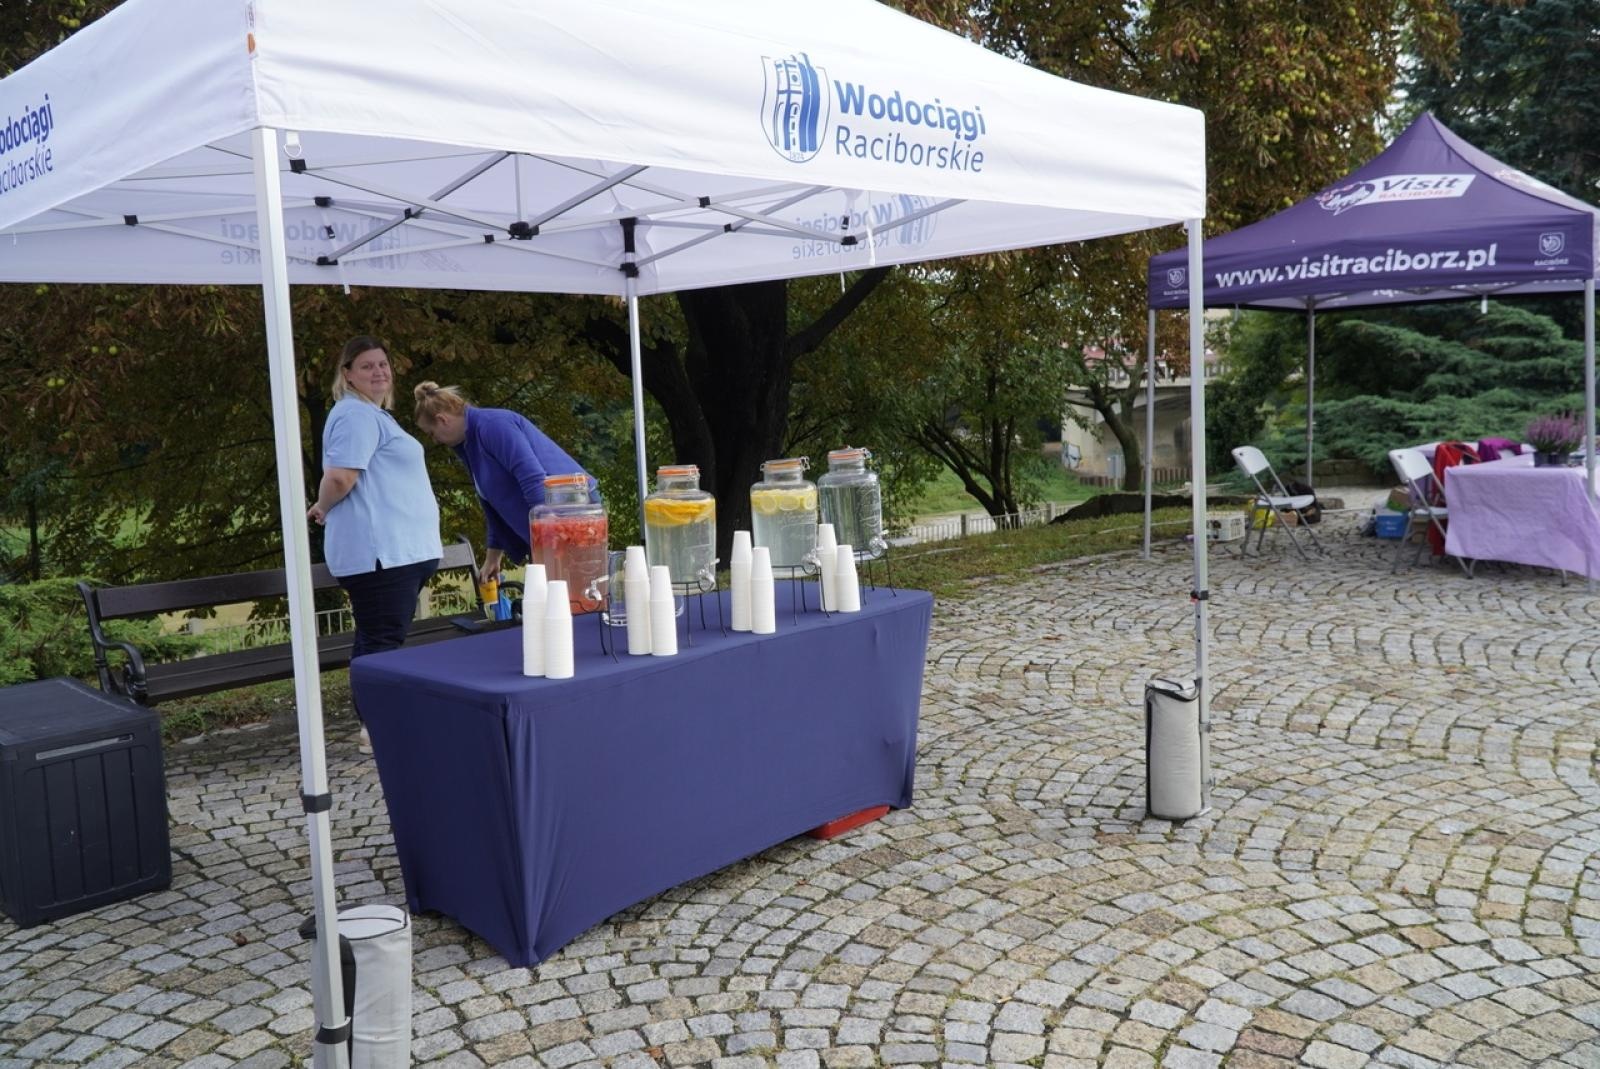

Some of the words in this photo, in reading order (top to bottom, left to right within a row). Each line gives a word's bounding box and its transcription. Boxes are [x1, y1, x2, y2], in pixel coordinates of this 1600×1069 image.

[834, 79, 986, 141] Wodociągi
[836, 125, 984, 173] Raciborskie
[1382, 176, 1463, 191] Visit
[1215, 243, 1498, 288] www.visitraciborz.pl
